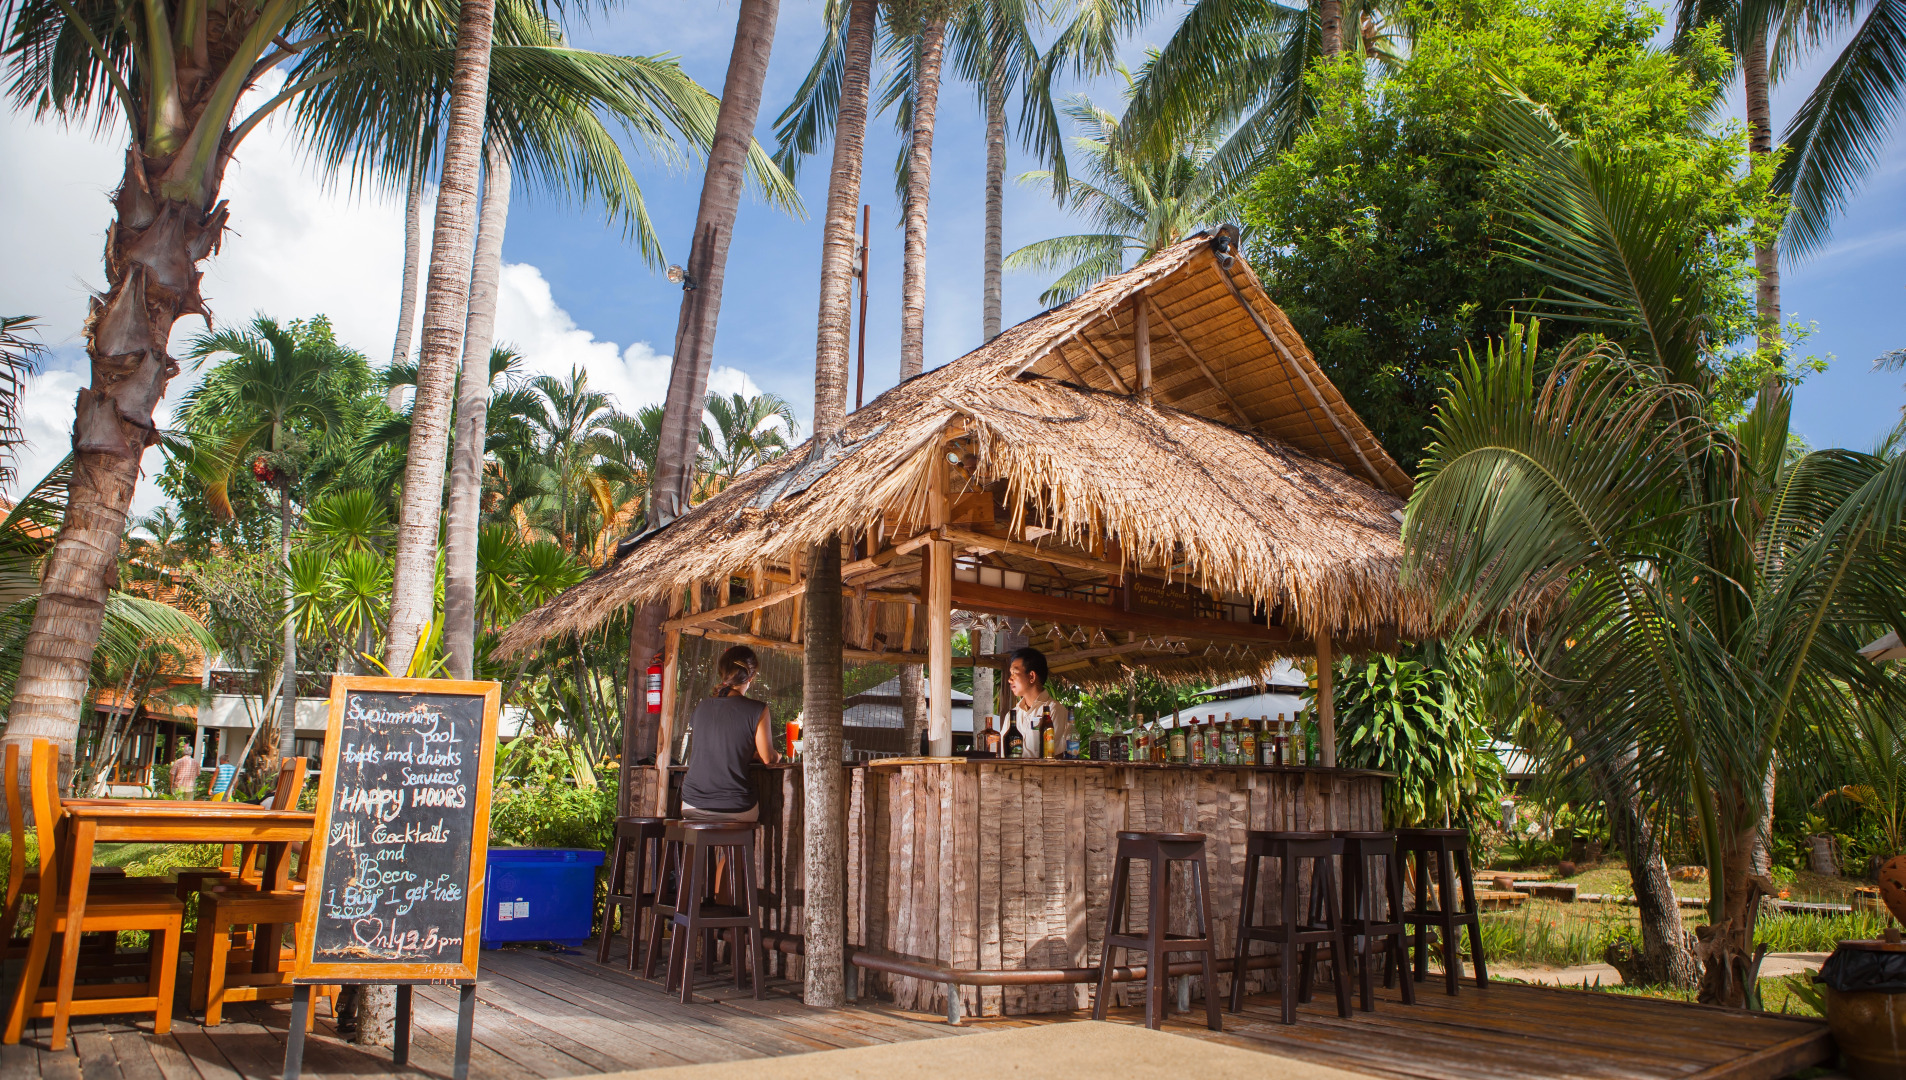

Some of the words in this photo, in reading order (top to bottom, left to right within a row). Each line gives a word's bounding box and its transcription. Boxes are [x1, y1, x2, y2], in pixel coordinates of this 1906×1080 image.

[1134, 582, 1165, 598] Opening
[1166, 589, 1191, 600] Hours
[347, 696, 440, 735] Swimming
[384, 742, 413, 764] and
[417, 745, 462, 766] drinks
[402, 767, 462, 786] Services
[339, 785, 405, 822] HAPPY
[412, 785, 467, 808] HOURS
[372, 818, 451, 844] Cocktails
[376, 844, 406, 861] and
[356, 859, 415, 889] Beer
[396, 879, 430, 916] get
[430, 876, 463, 902] free
